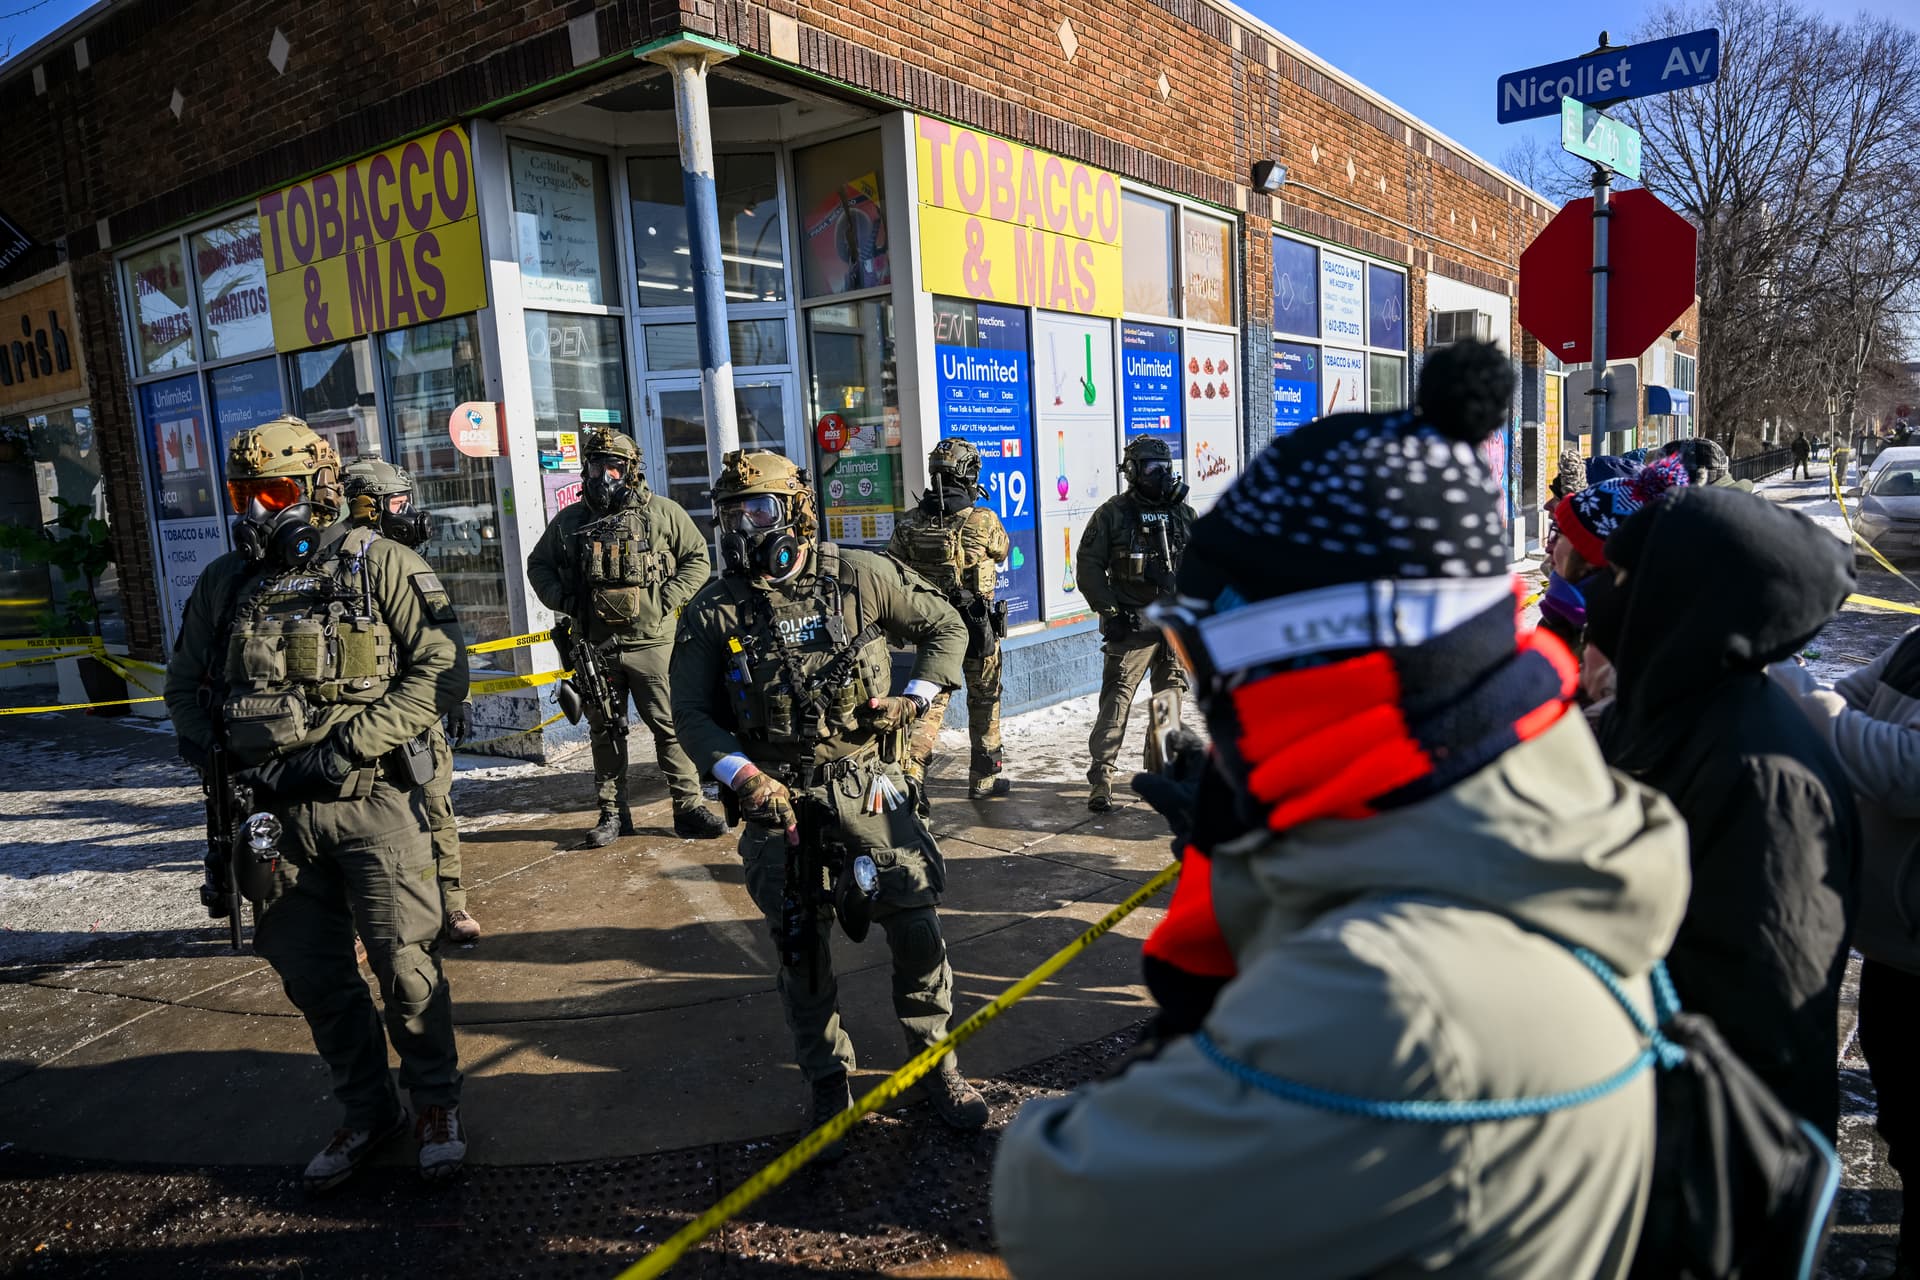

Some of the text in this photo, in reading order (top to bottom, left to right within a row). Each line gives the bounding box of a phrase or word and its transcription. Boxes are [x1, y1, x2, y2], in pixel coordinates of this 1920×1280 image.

[1504, 46, 1712, 111] Nicollet Av
[1566, 107, 1576, 140] E
[1587, 117, 1620, 159] 27th
[529, 155, 570, 175] Celular
[524, 170, 578, 190] Prepagado
[919, 115, 1119, 244] TOBACCO
[258, 129, 468, 273] TOBACCO
[962, 218, 1096, 313] & MAS
[303, 231, 446, 345] & MAS
[209, 286, 266, 325] JARRITOS
[943, 353, 1019, 383] Unlimited
[1127, 356, 1172, 378] Unlimited
[153, 384, 193, 408] Unlimited
[952, 389, 963, 399] Talk
[978, 390, 989, 399] Text
[1274, 386, 1302, 403] nlimited
[218, 407, 252, 424] Unlimited
[459, 430, 490, 442] BOSS
[824, 430, 841, 438] BOSS
[834, 459, 879, 474] Unlimited
[990, 470, 1026, 518] $19
[1142, 513, 1169, 522] POLICE
[164, 527, 220, 541] TOBACCO & MAS
[172, 551, 197, 563] CIGARS
[779, 615, 824, 634] OLICE
[27, 640, 44, 648] POLICE
[45, 639, 56, 647] LINE
